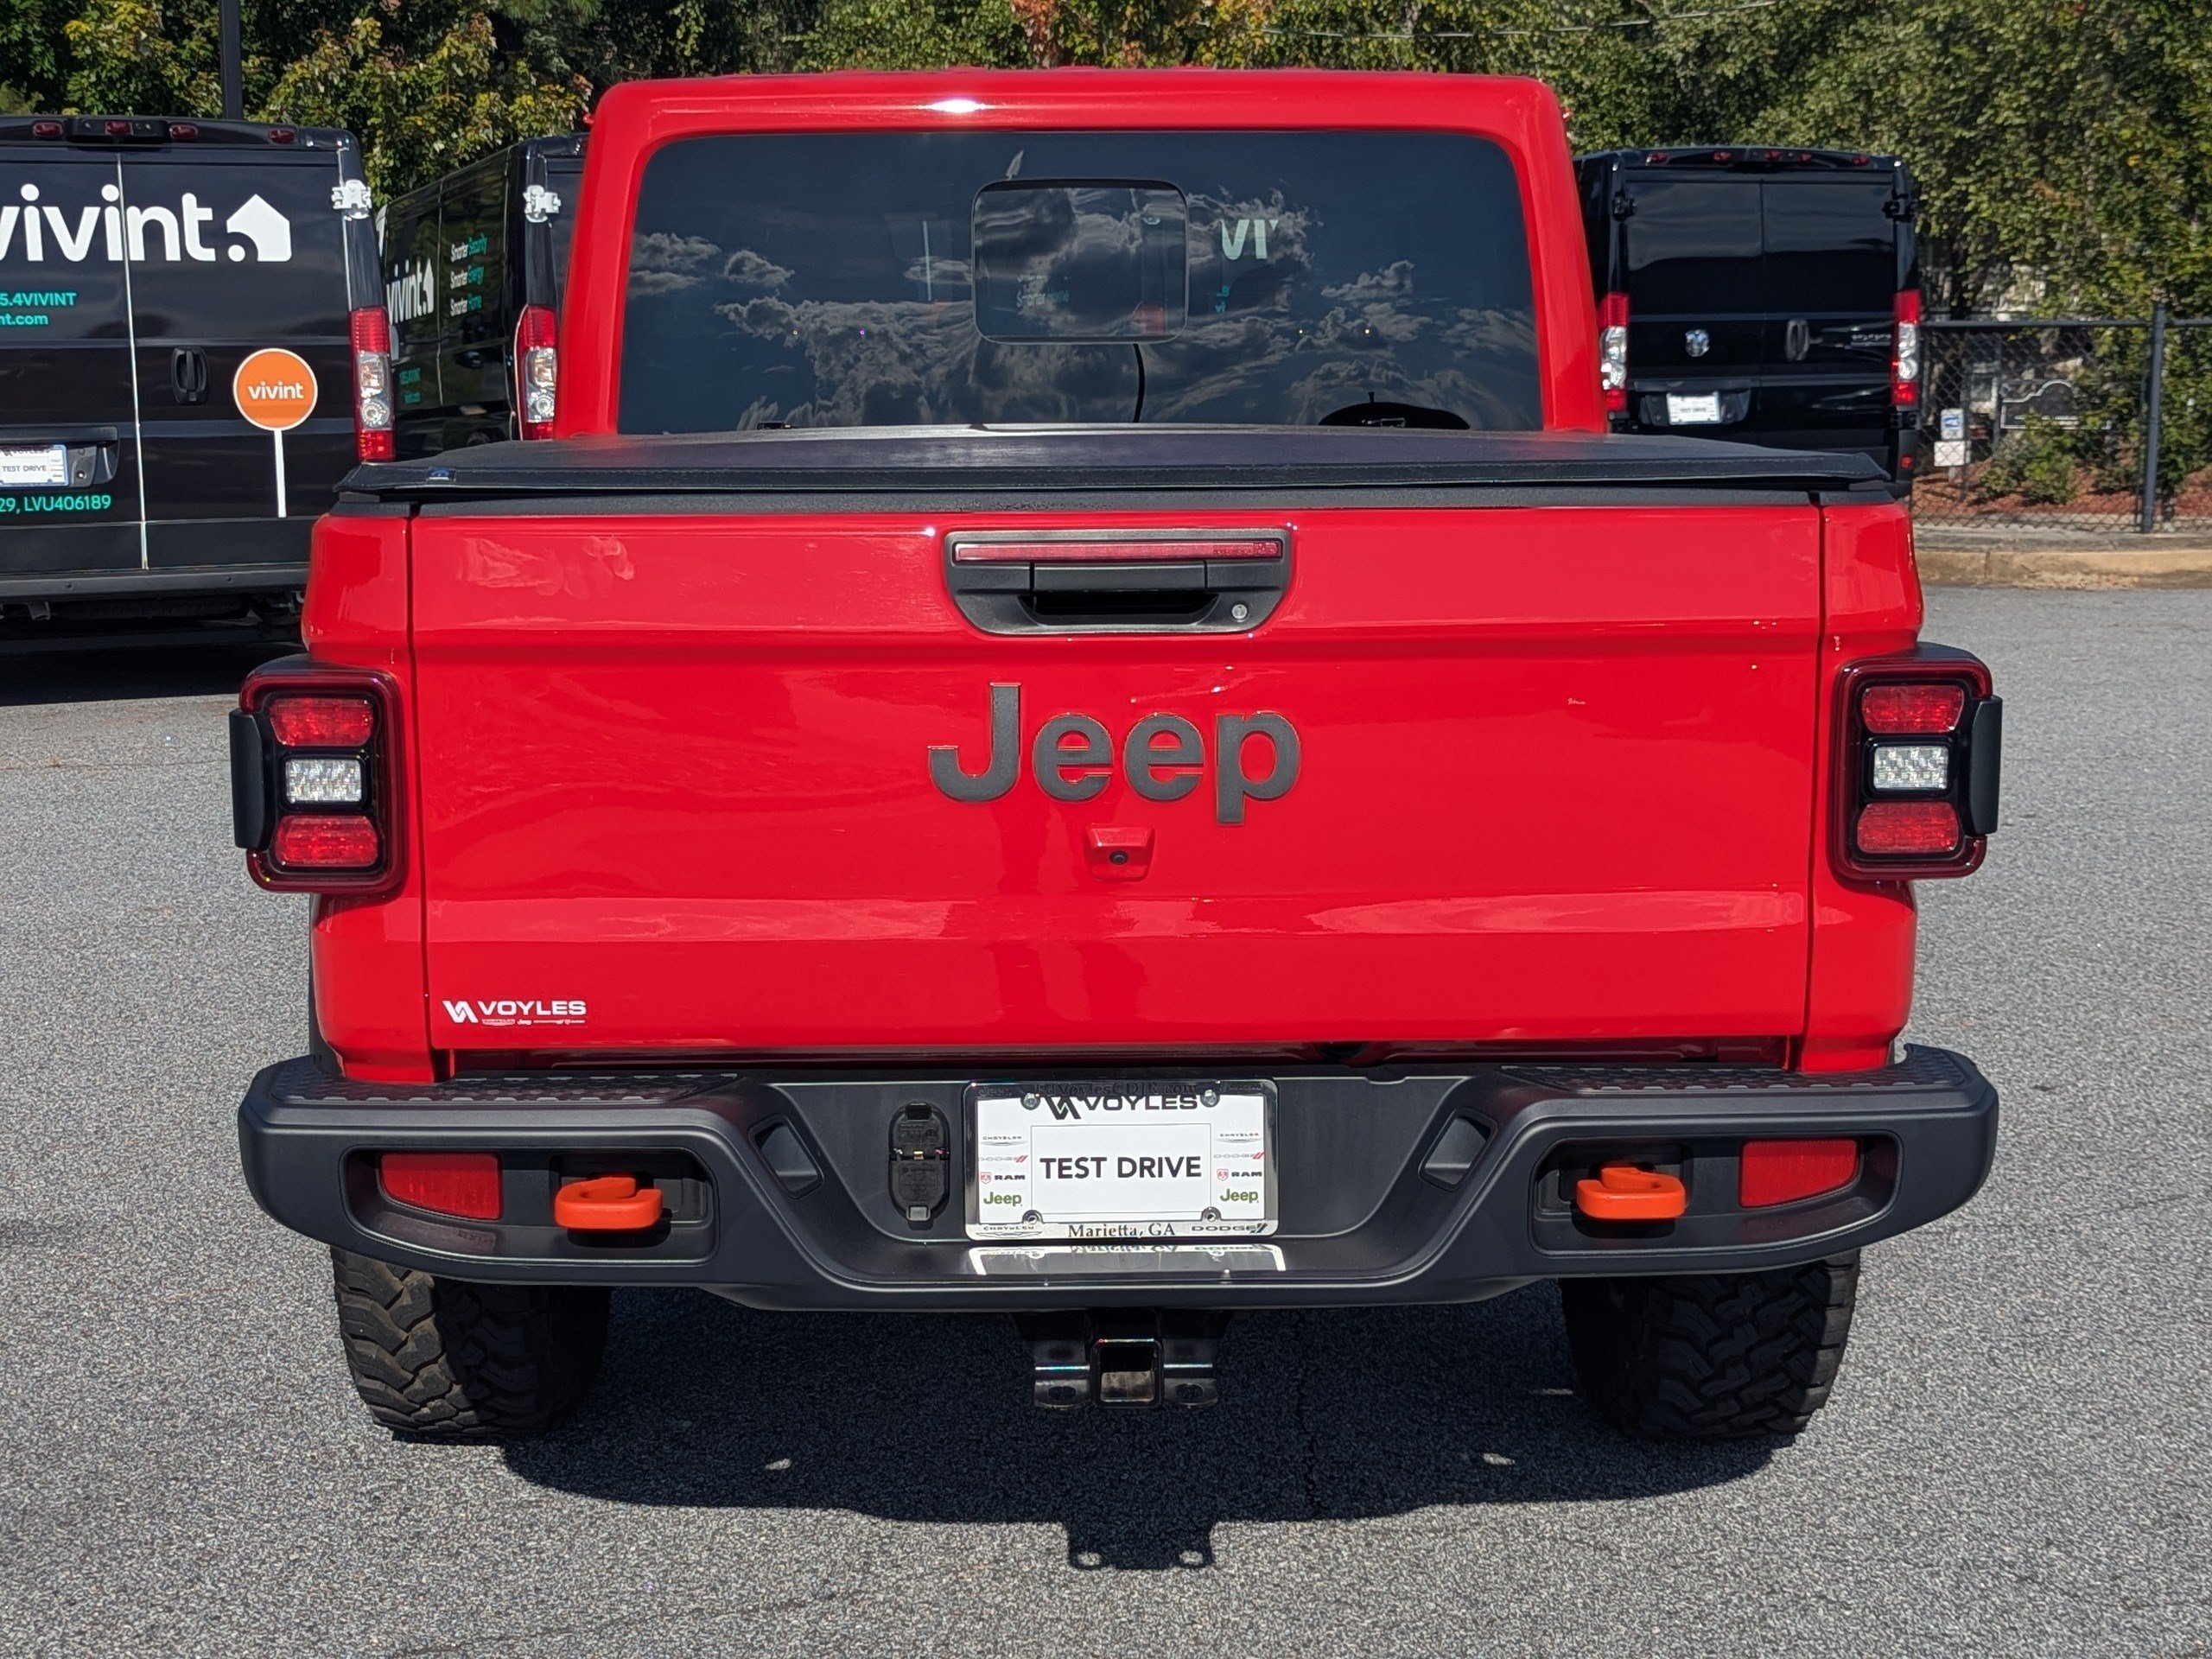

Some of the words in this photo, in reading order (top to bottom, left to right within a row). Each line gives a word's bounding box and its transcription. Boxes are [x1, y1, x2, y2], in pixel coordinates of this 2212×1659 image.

[386, 259, 423, 325] vivint
[247, 380, 304, 400] vivint
[24, 494, 112, 512] LVU406189
[928, 682, 1301, 825] Jeep
[477, 1000, 587, 1016] VOYLES
[1083, 1095, 1198, 1111] VOYLES
[1039, 1156, 1108, 1179] TEST
[1117, 1155, 1202, 1179] DRIVE
[982, 1192, 1023, 1207] Jeep
[1219, 1188, 1259, 1205] Jeep
[1067, 1223, 1144, 1238] Marietta,
[1147, 1223, 1176, 1236] GA
